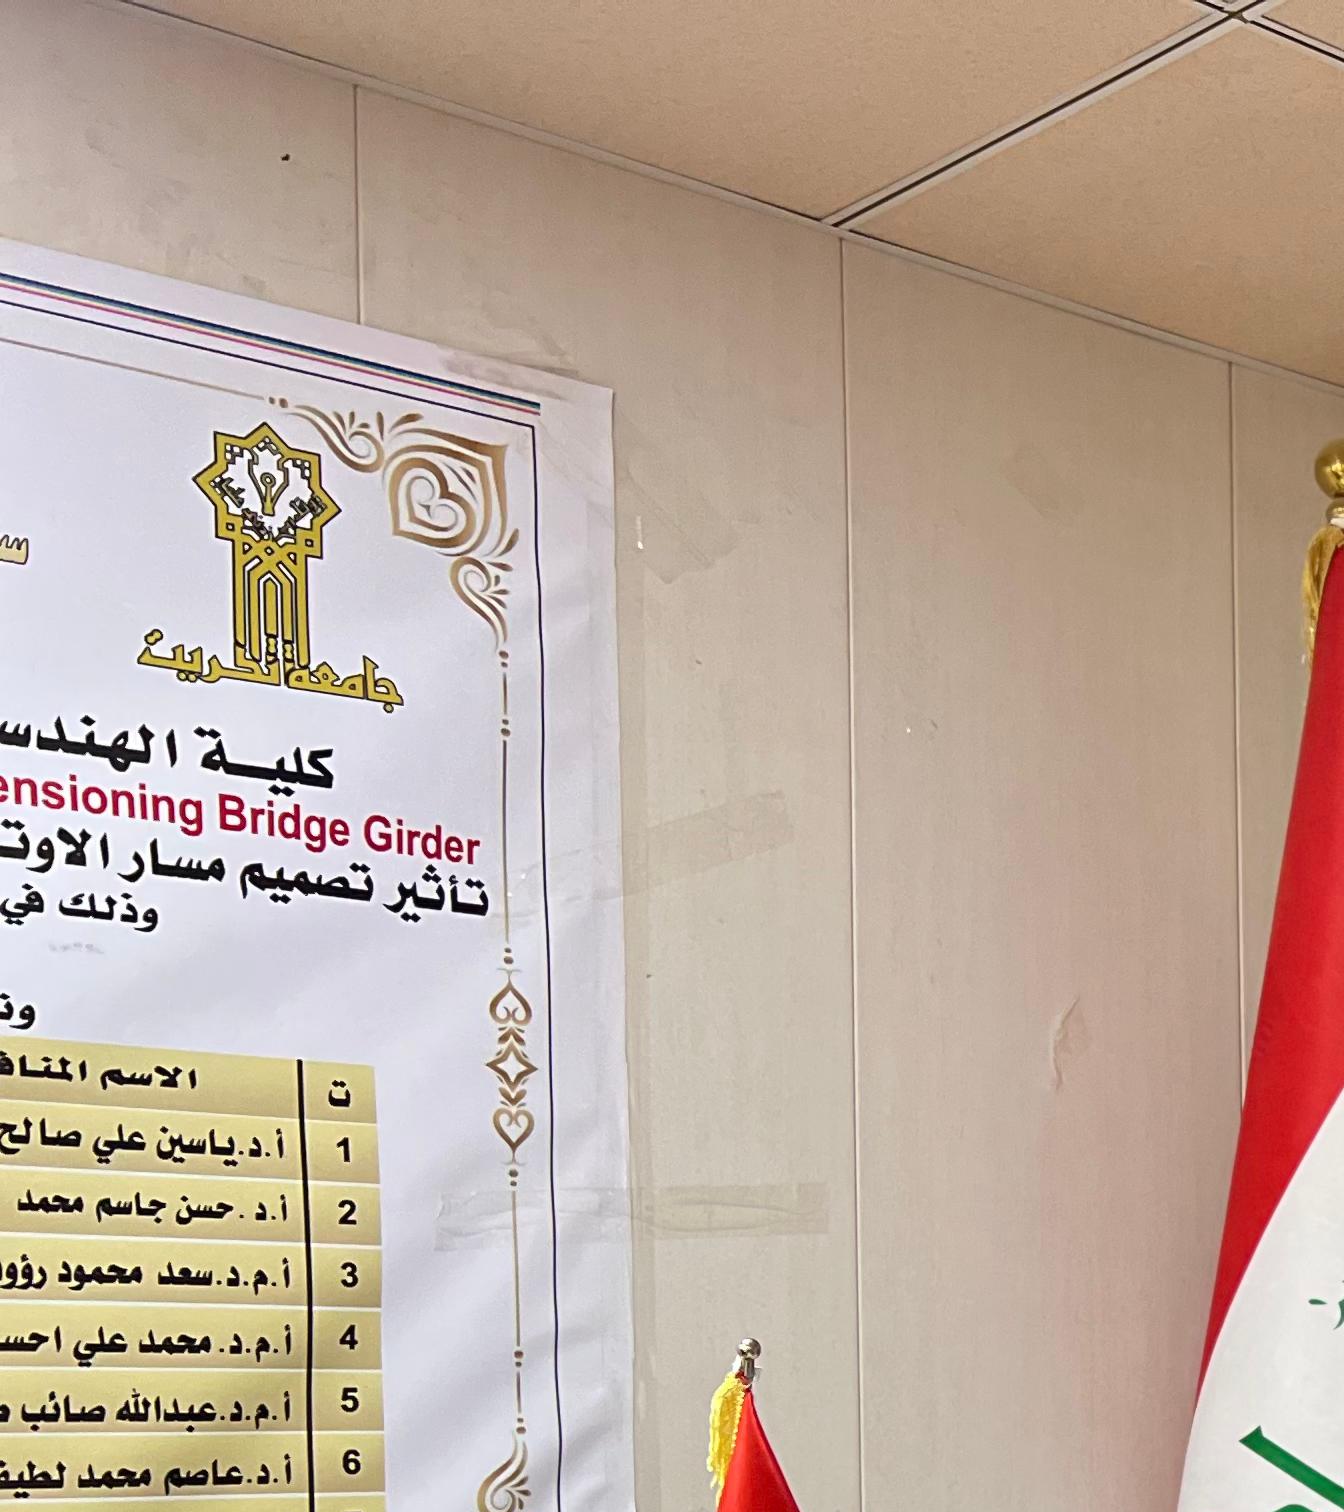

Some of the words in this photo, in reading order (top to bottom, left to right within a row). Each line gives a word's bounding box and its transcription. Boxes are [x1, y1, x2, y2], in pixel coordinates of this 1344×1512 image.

[0, 714, 178, 772] الهندس
[193, 726, 334, 797] كلية
[217, 792, 350, 853] Bridge
[363, 814, 481, 865] Girder
[0, 818, 110, 874] الاوت
[117, 838, 226, 883] مسار
[239, 862, 374, 905] تصميم
[382, 863, 489, 923] تأثير
[0, 883, 45, 926] في
[58, 892, 159, 933] وذلك
[100, 1065, 197, 1091] الاسم
[328, 1079, 351, 1108] ت
[92, 1123, 147, 1164] علي
[336, 1136, 351, 1163] 1
[17, 1189, 84, 1214] محمد
[96, 1191, 167, 1223] جاسم
[338, 1199, 358, 1225] 2
[0, 1253, 47, 1290] رؤو
[58, 1260, 143, 1291] محمود
[340, 1261, 360, 1288] 3
[0, 1325, 62, 1352] احس
[73, 1325, 128, 1367] علي
[339, 1324, 359, 1350] 4
[21, 1390, 106, 1432] صائب
[340, 1386, 360, 1413] 5
[77, 1463, 152, 1490] محمد
[342, 1449, 362, 1475] 6
